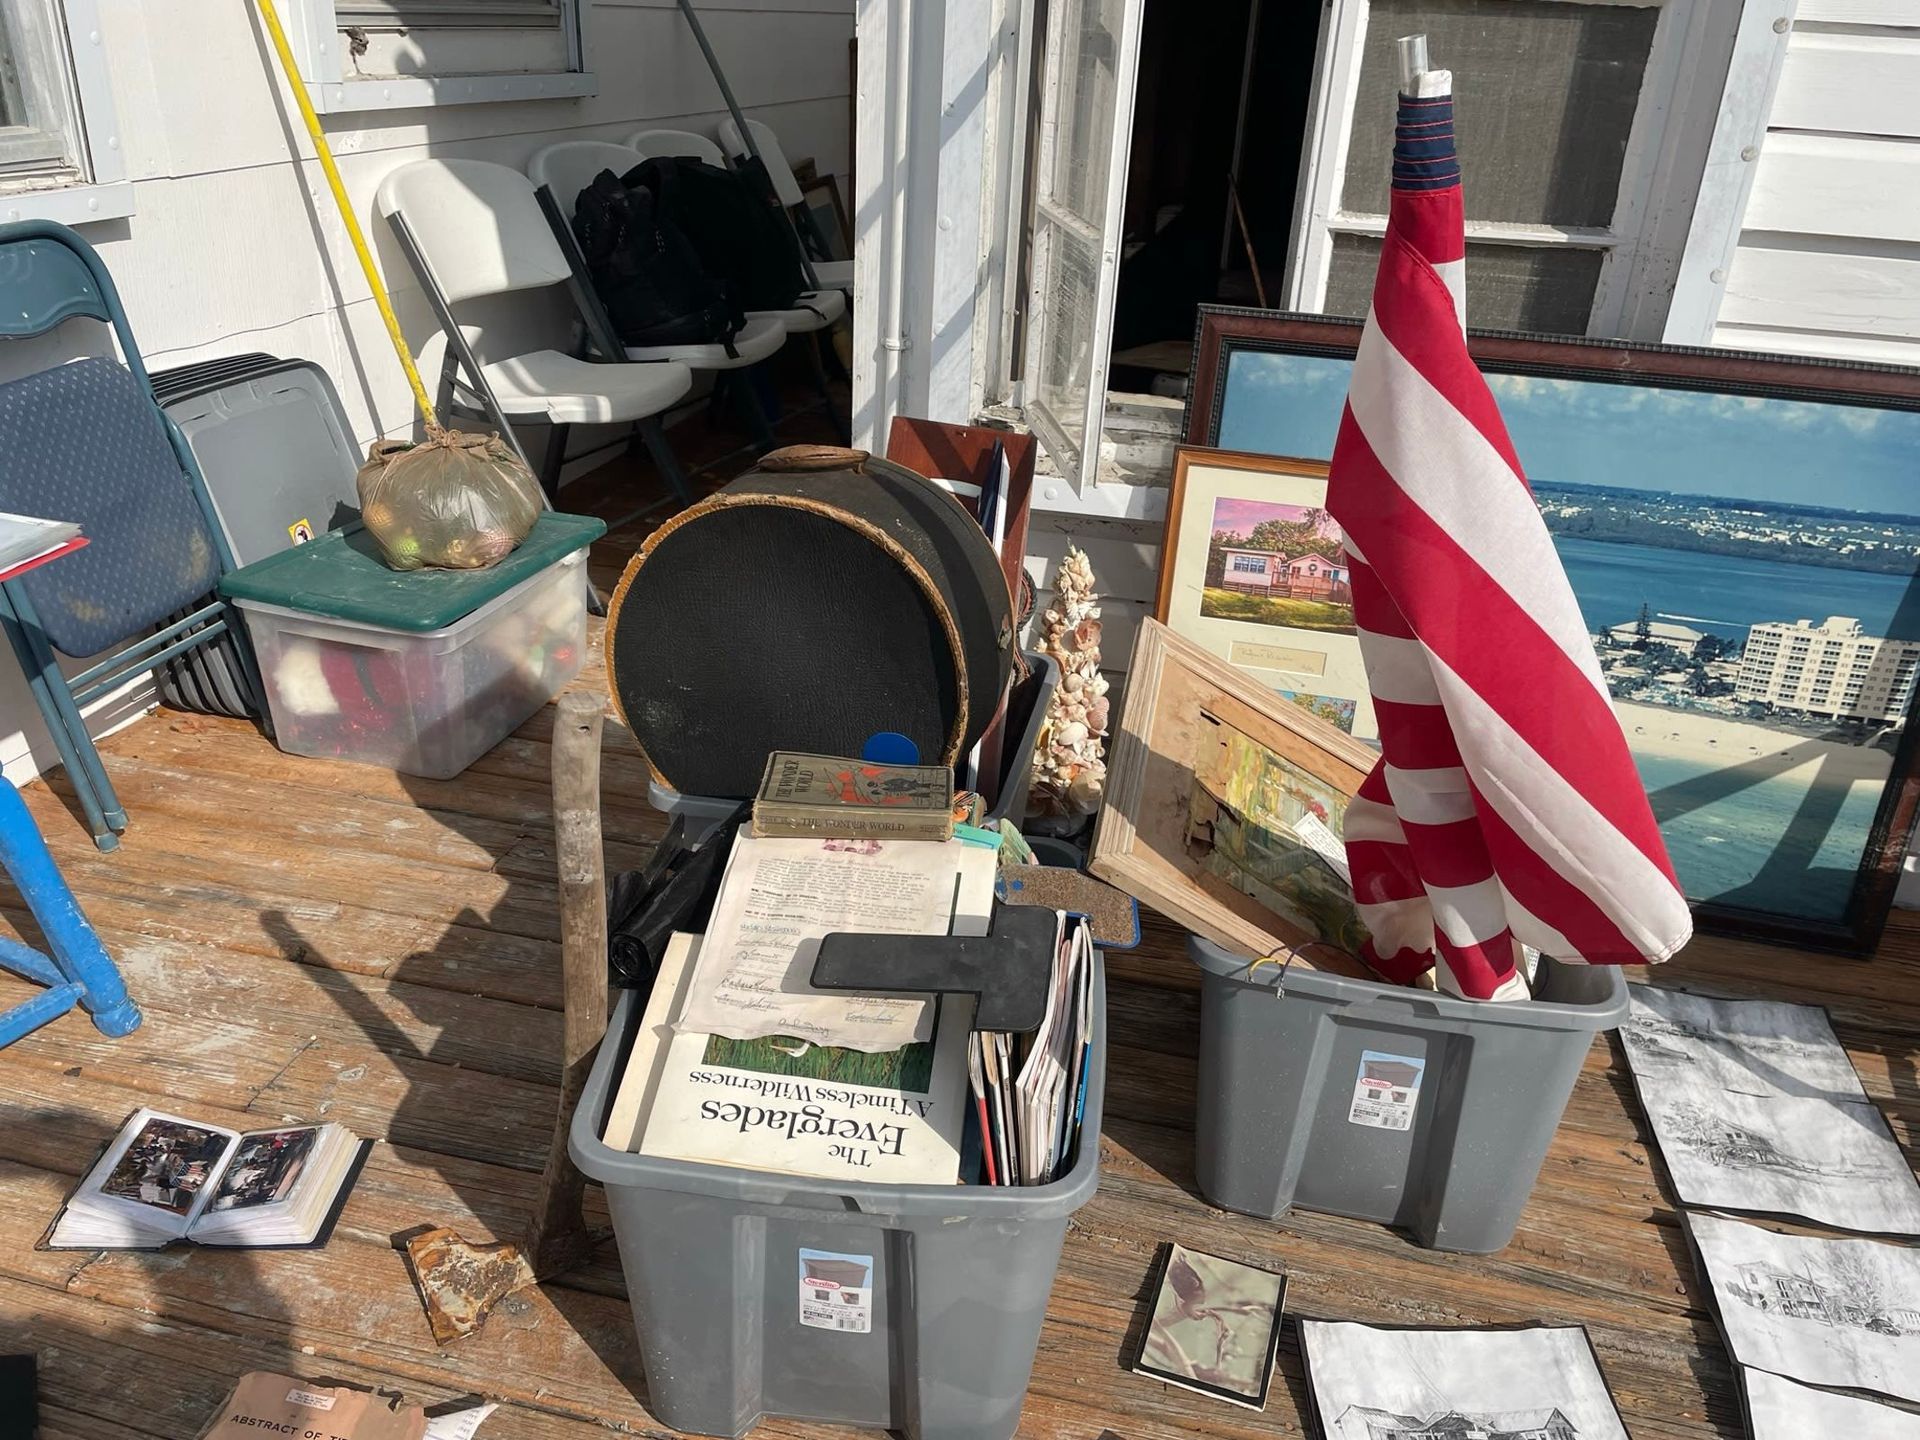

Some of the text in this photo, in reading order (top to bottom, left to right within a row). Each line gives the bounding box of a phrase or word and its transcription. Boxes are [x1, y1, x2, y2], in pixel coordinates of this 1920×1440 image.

[794, 770, 814, 793] WORLD
[825, 819, 867, 830] WONDER
[869, 822, 905, 832] WORLD
[689, 1071, 934, 1118] A Timeless Wilderness
[701, 1100, 909, 1157] Everglades
[828, 1144, 872, 1167] The
[231, 1414, 323, 1440] ABSTRACT OF
